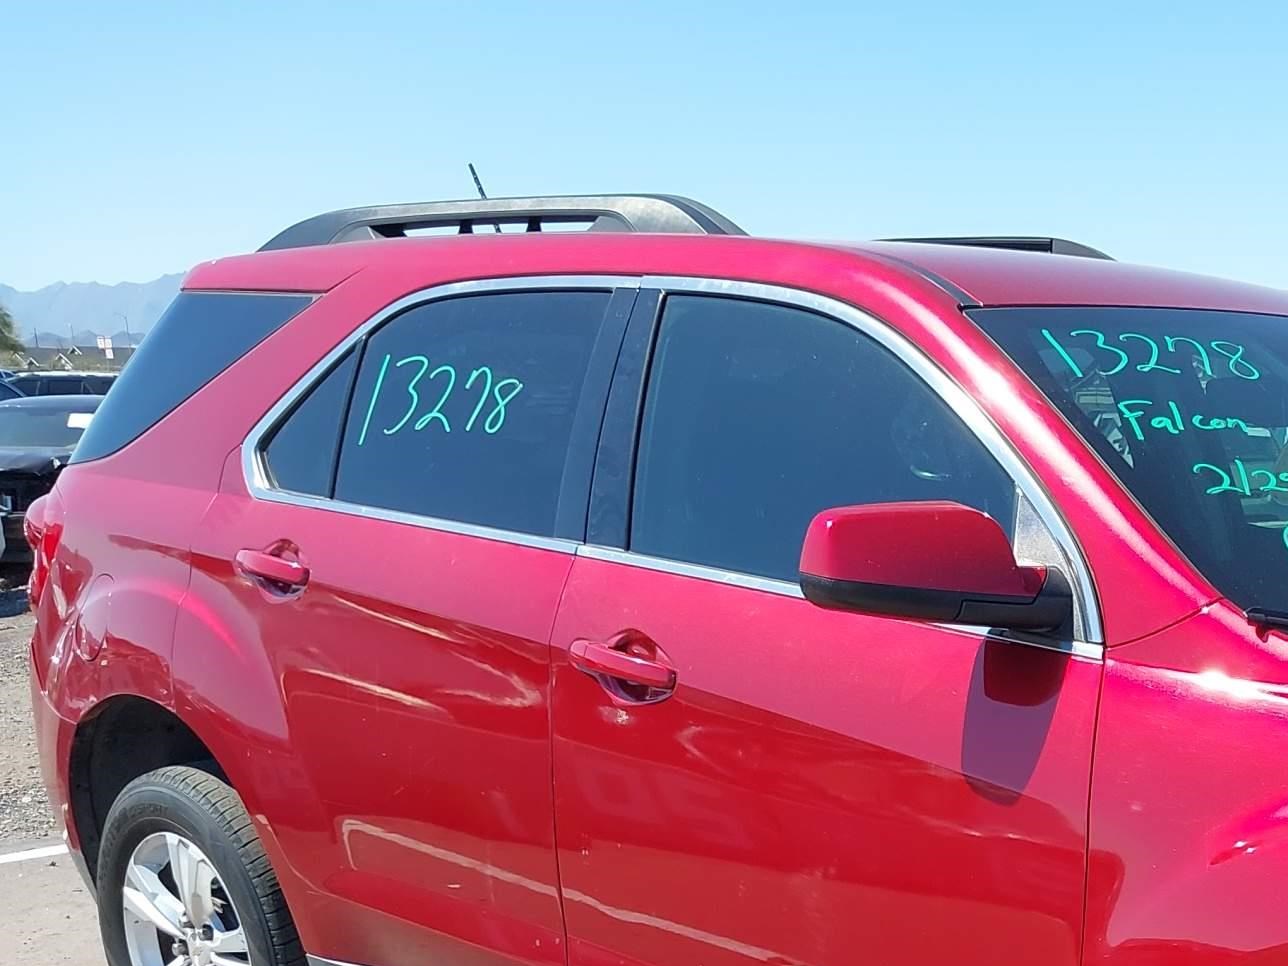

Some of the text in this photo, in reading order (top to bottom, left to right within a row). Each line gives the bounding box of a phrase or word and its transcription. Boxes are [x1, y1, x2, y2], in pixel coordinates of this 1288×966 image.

[1041, 327, 1261, 380] 13278
[357, 353, 525, 446] 13278
[1117, 399, 1249, 441] Falcon
